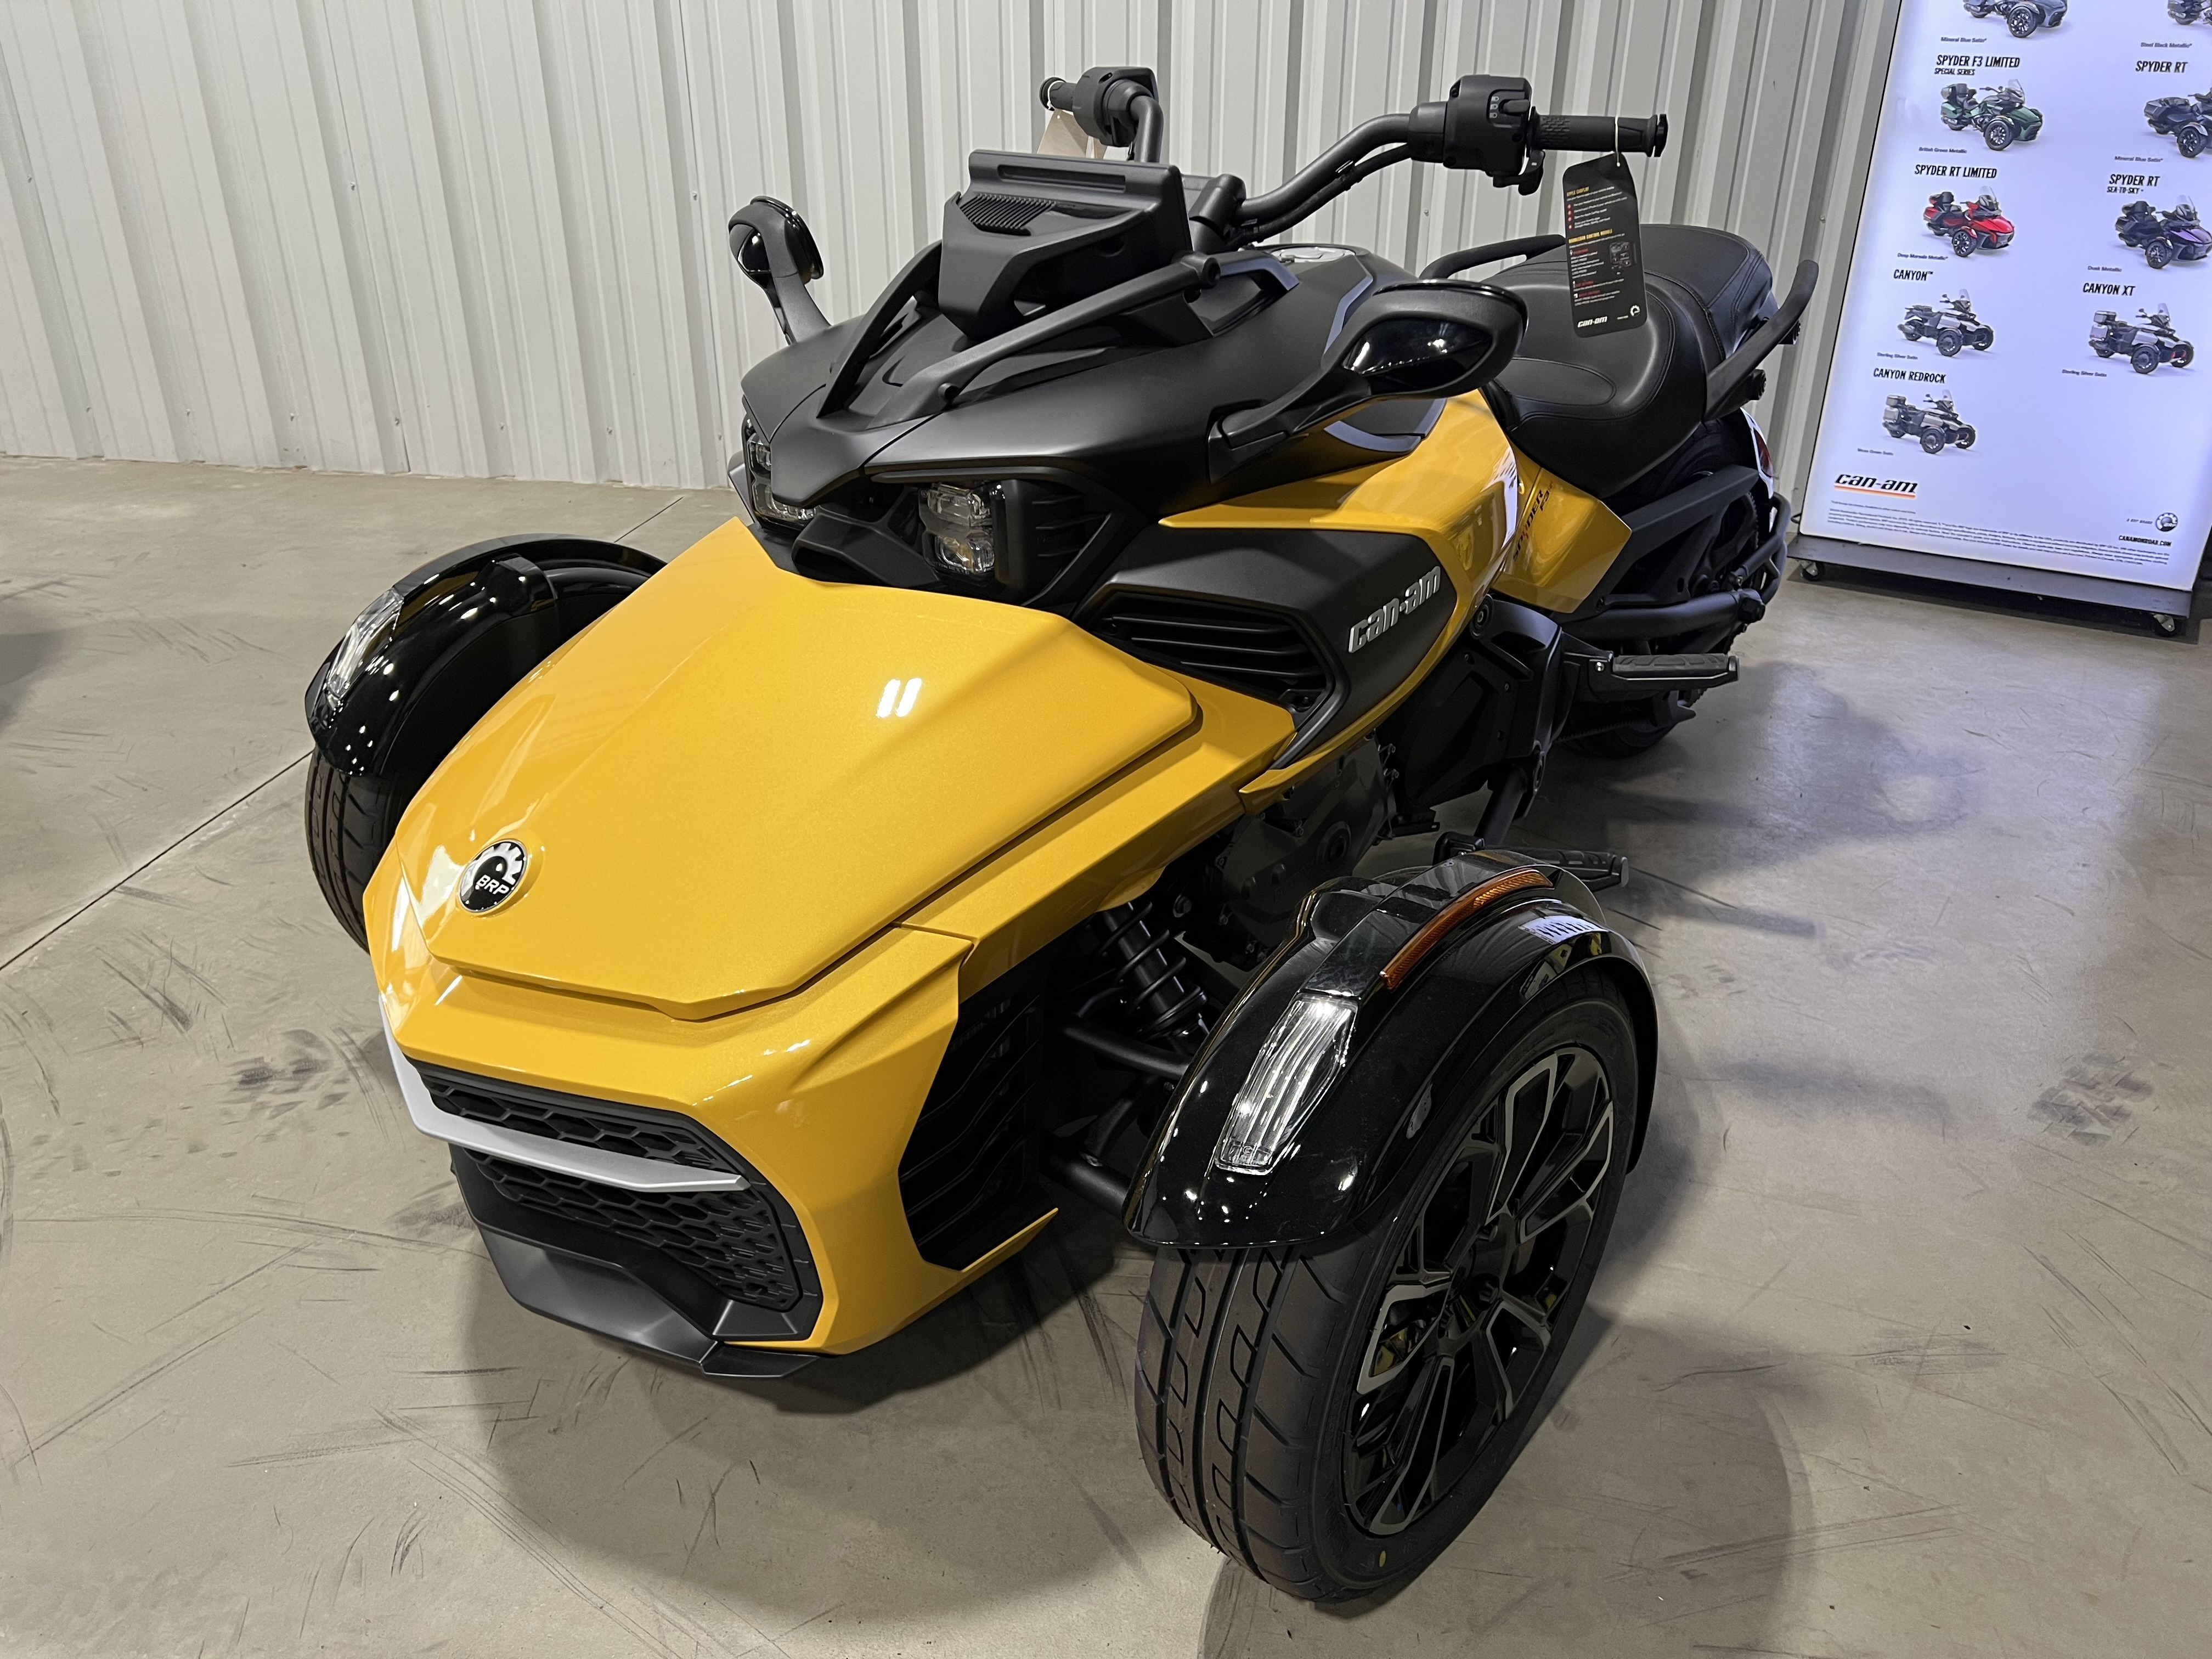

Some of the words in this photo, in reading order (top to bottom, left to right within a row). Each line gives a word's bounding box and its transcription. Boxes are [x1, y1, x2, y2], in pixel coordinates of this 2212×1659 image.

[1937, 55, 1970, 66] SPYDER
[1972, 56, 1983, 66] F3
[1985, 57, 2020, 67] LIMITED
[2136, 61, 2172, 72] SPYDER
[2174, 62, 2188, 72] RT
[1915, 165, 1947, 176] SPYDER
[1949, 166, 1961, 177] RT
[1963, 167, 1997, 178] LIMITED
[2109, 174, 2145, 185] SPYDER
[2147, 176, 2160, 186] RT
[2083, 283, 2120, 295] CANYON
[2121, 285, 2135, 296] XT
[1577, 316, 1608, 328] can-am
[1874, 368, 1906, 379] CANYON
[1909, 371, 1946, 383] REDROCK
[1836, 474, 1918, 493] can-am
[1348, 566, 1441, 653] can-am
[476, 874, 510, 895] BRP
